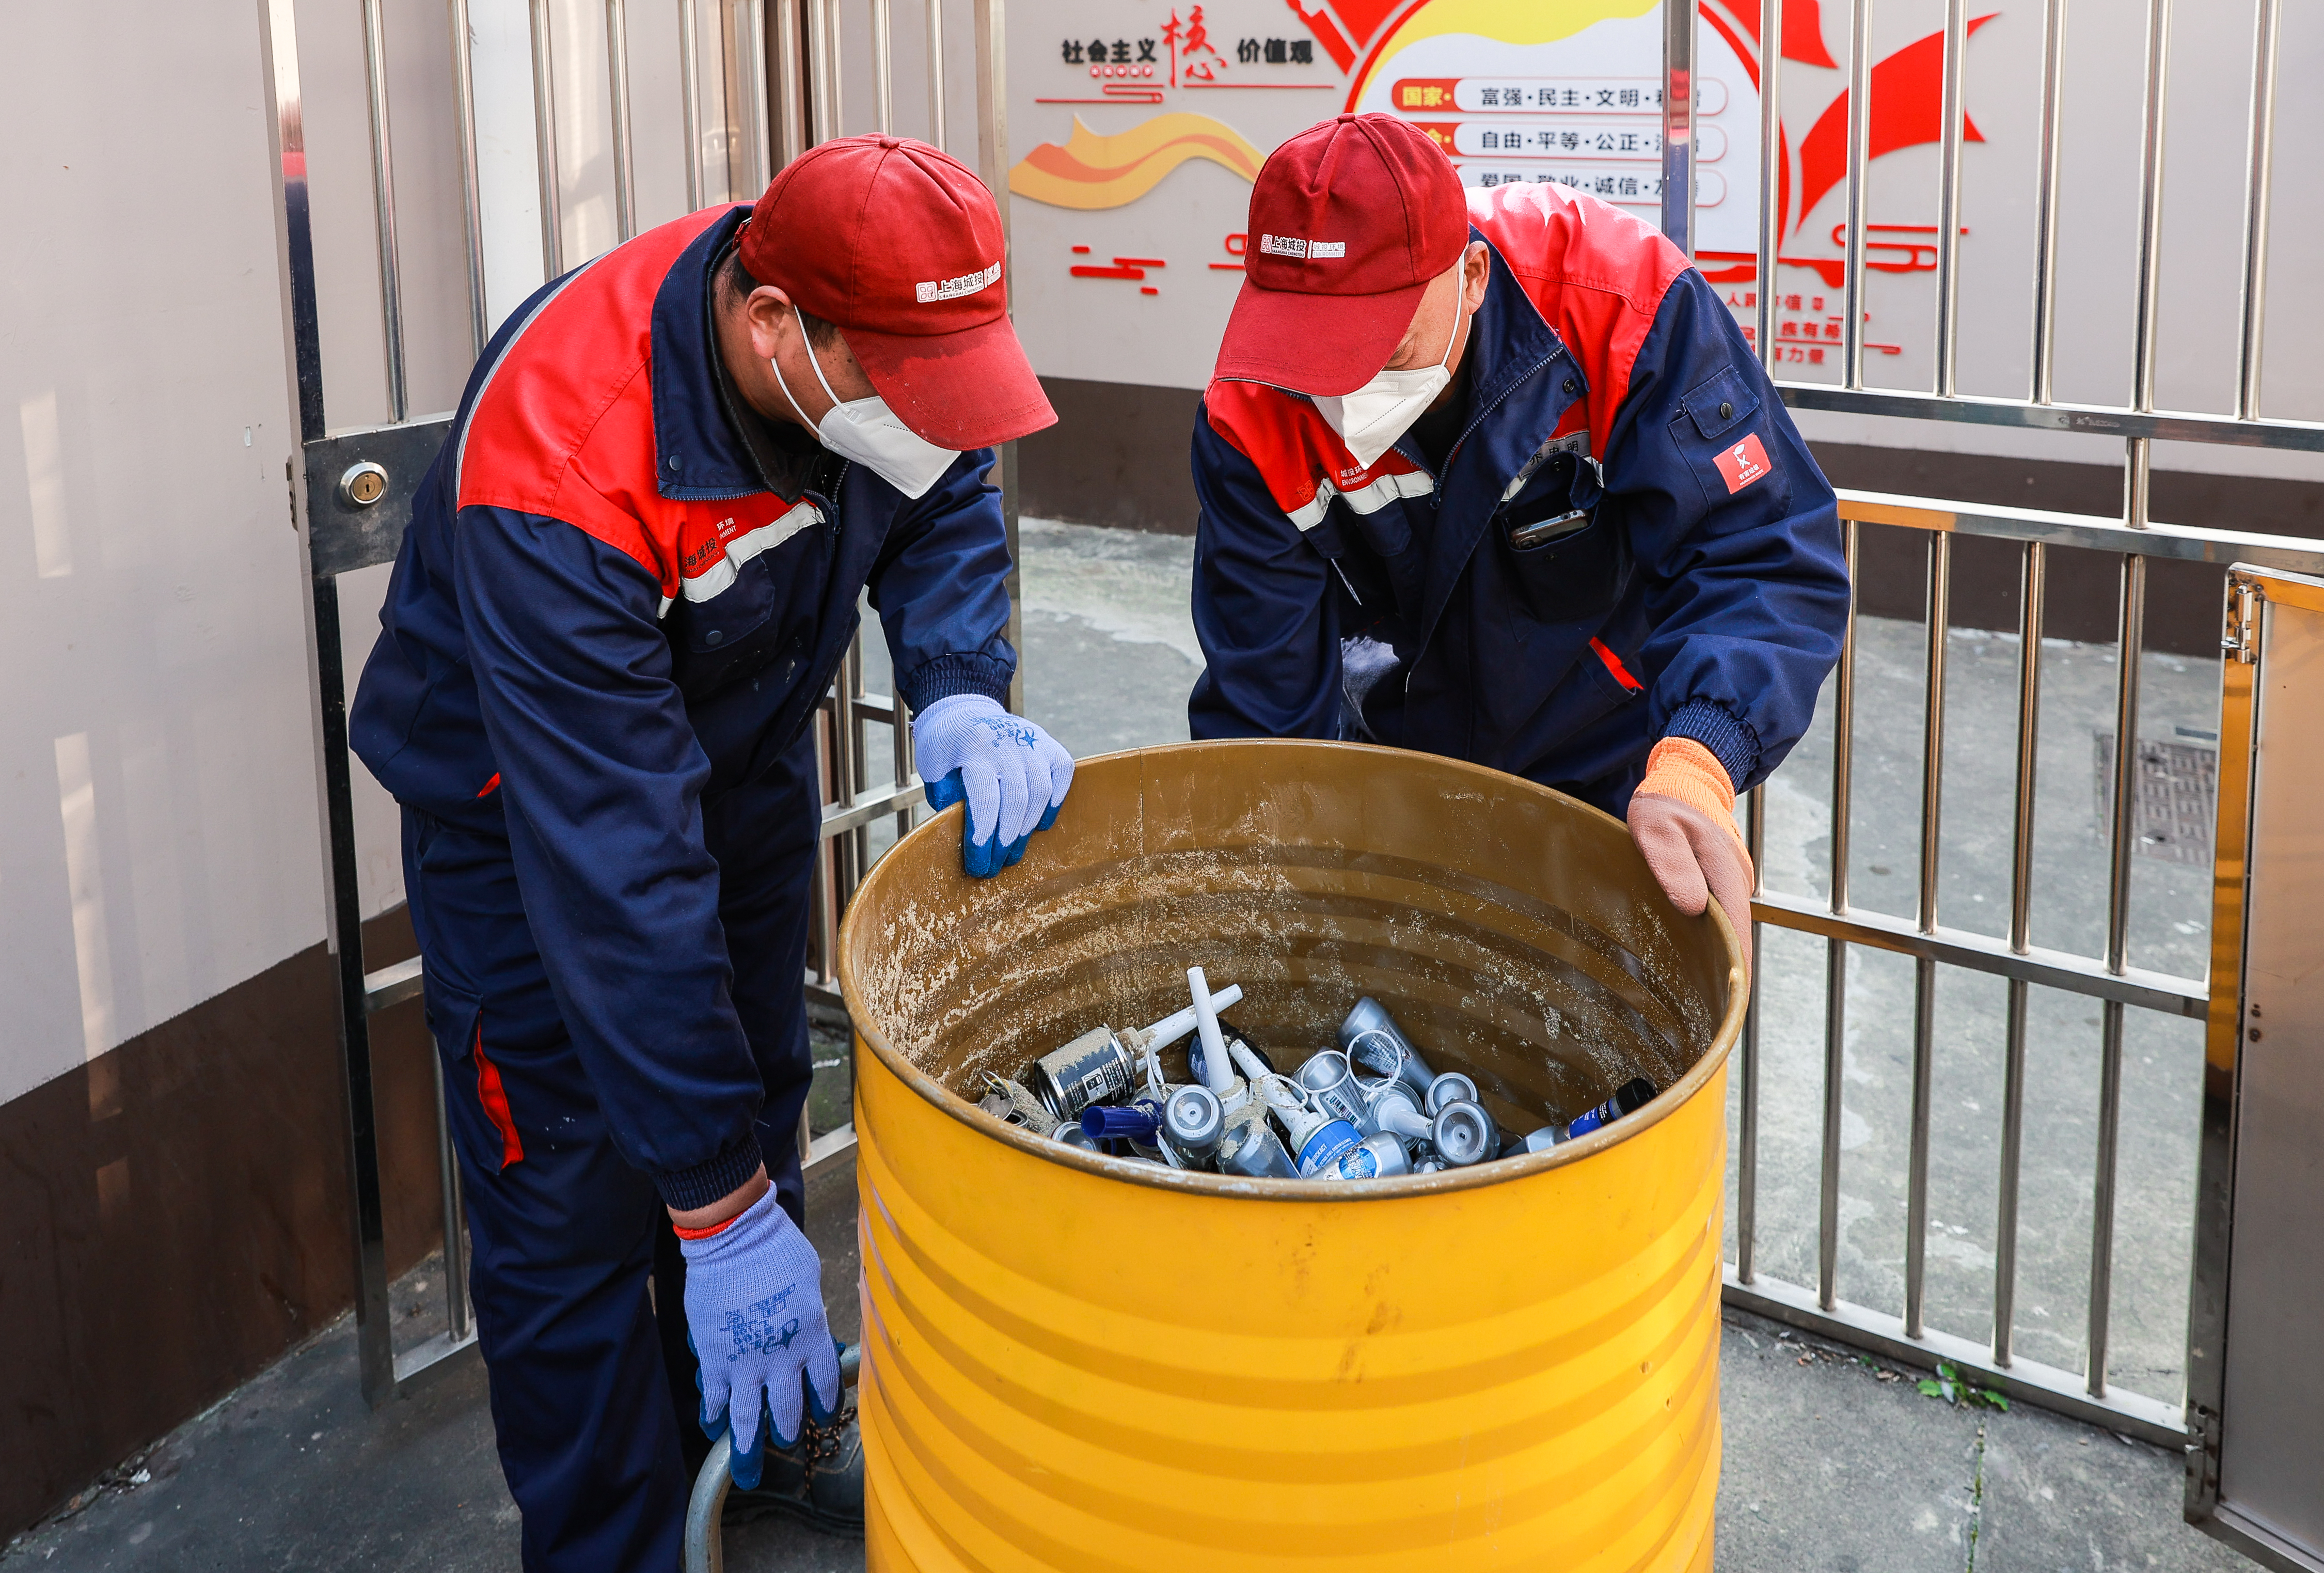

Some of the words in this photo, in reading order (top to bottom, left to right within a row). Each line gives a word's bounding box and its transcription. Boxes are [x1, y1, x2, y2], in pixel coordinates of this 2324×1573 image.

[1062, 38, 1157, 63] 社会主义
[1238, 38, 1313, 63] 价值观
[1272, 237, 1305, 251] 上海城投
[939, 273, 983, 293] 上海城投
[1738, 463, 1760, 480] 有害垃圾
[716, 517, 735, 531] 环境
